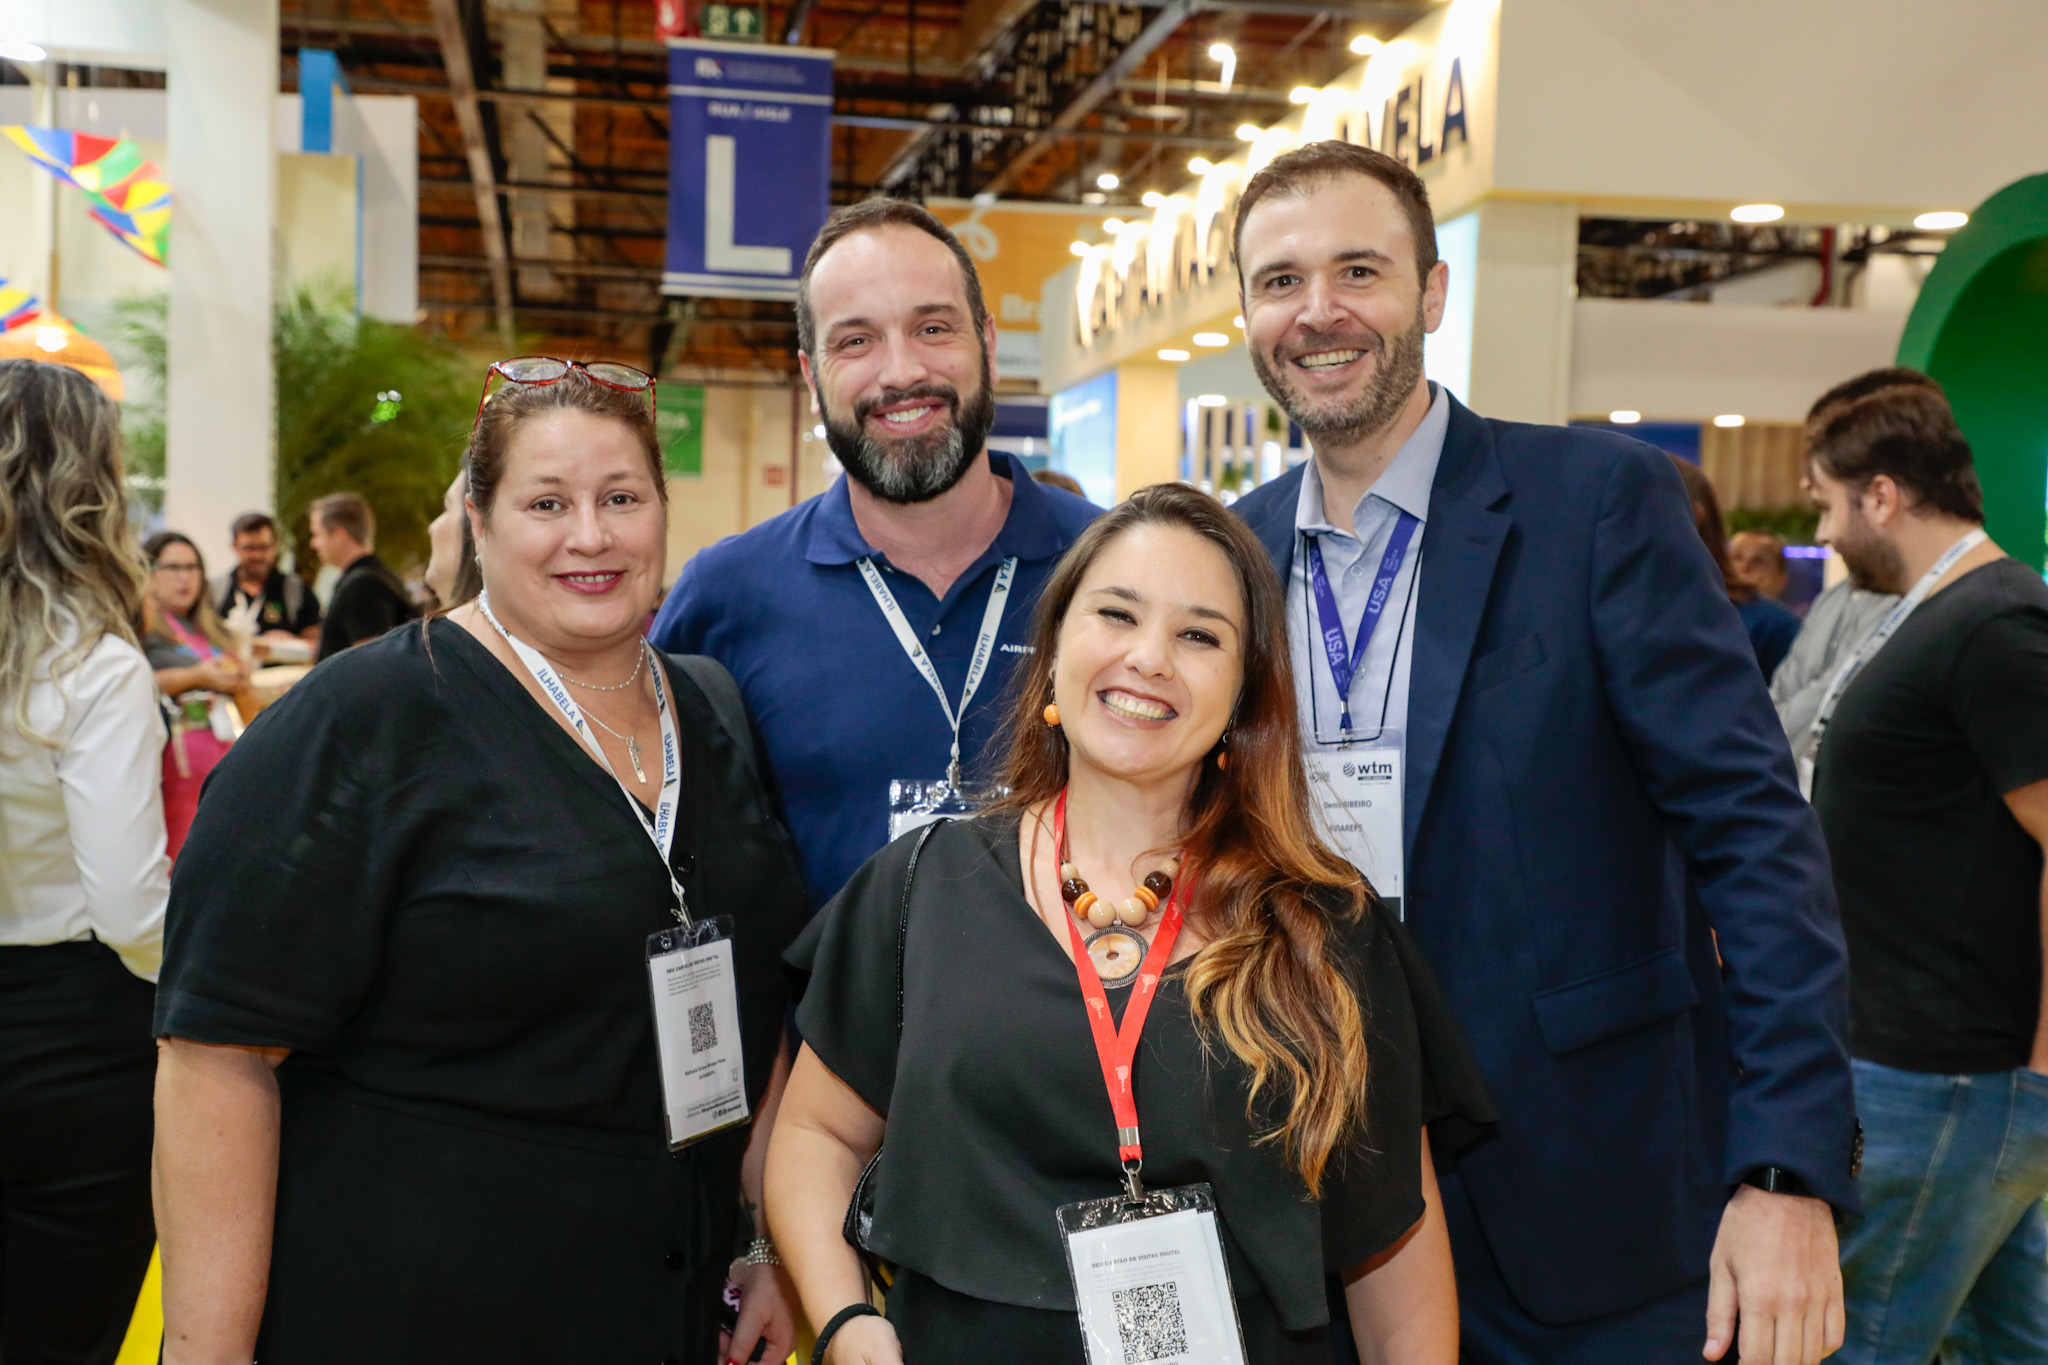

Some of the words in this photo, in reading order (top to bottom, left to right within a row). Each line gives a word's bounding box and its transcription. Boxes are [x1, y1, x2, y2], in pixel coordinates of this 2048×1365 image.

[705, 135, 792, 275] L
[865, 564, 896, 611] ILHABELA
[1368, 576, 1393, 615] USA
[966, 632, 991, 685] ILHABELA
[1325, 626, 1346, 667] USA
[537, 668, 576, 720] ILHABELA
[664, 731, 676, 779] ILHABELA
[1358, 761, 1392, 774] wtm
[1138, 1252, 1159, 1261] VISITAS
[1160, 1249, 1182, 1257] DIGITAL
